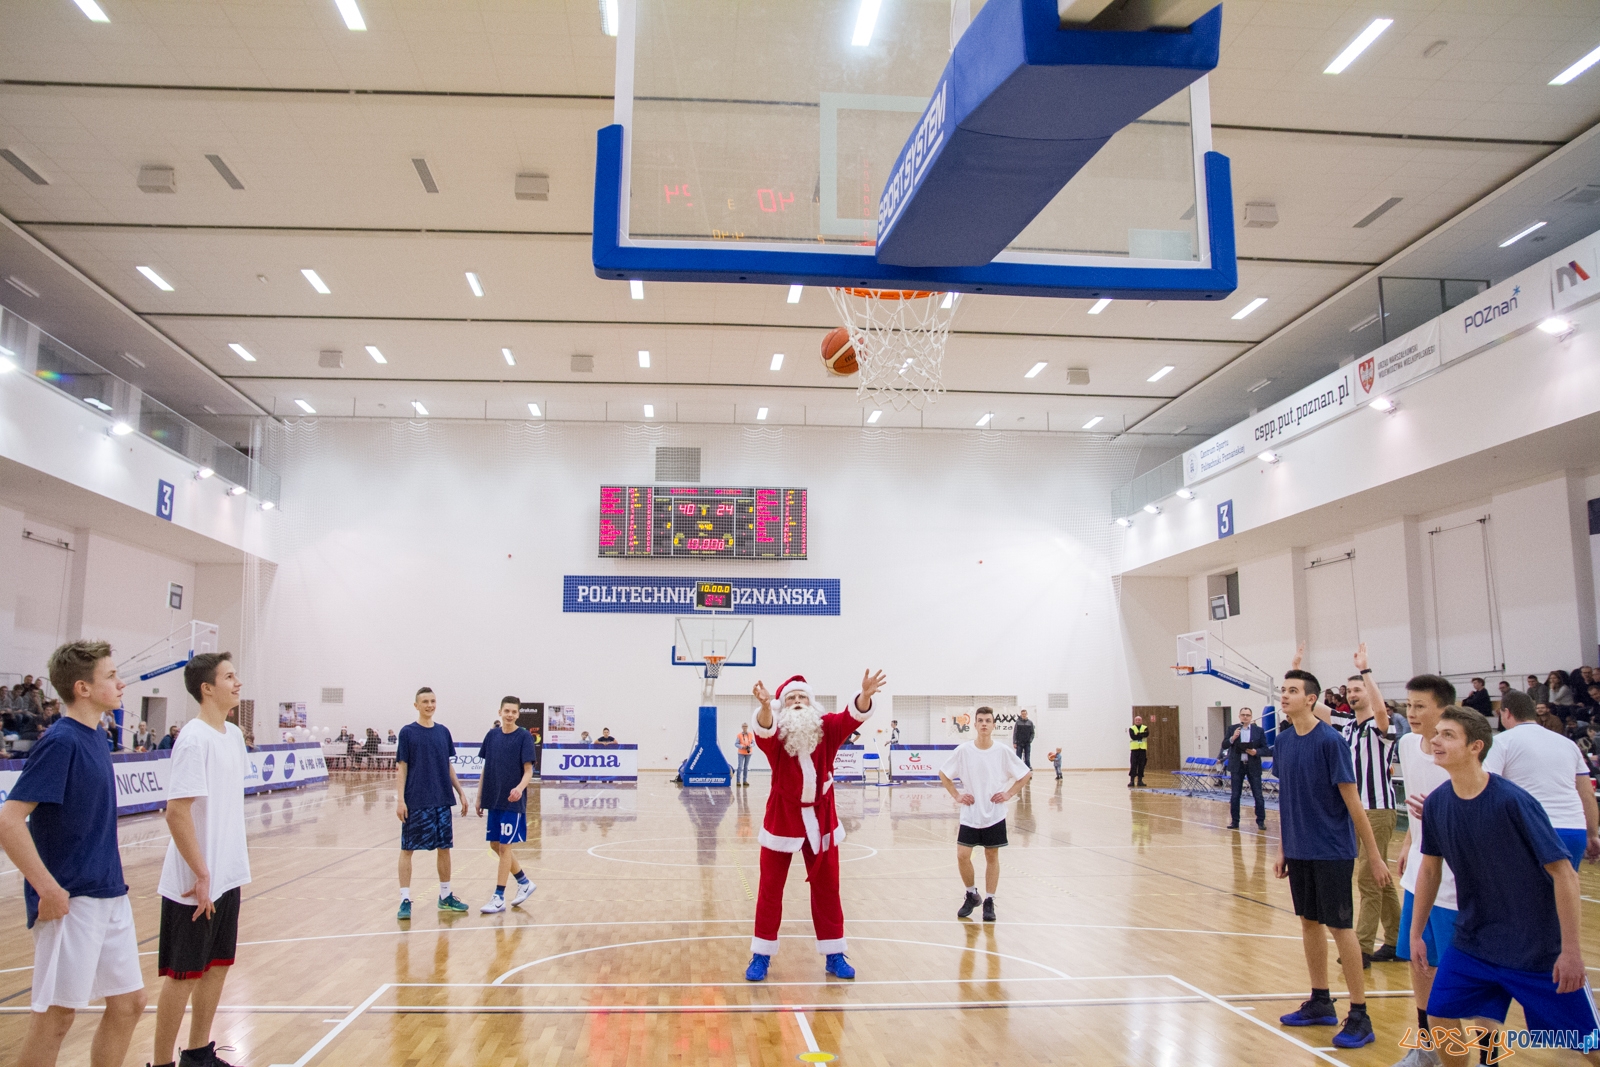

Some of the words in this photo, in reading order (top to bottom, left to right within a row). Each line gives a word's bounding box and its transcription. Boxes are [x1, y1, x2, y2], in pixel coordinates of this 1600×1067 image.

[879, 80, 947, 234] SPORTSYSTEM
[1254, 374, 1350, 441] cspp.put.poznan.pl
[161, 484, 172, 516] 3
[678, 504, 696, 516] 40
[716, 504, 734, 516] 24
[1220, 504, 1229, 534] 3
[577, 585, 697, 604] POLITECHNIK
[733, 584, 828, 606] OZNAŃSKA
[116, 771, 164, 796] NICKEL
[500, 822, 513, 837] 10
